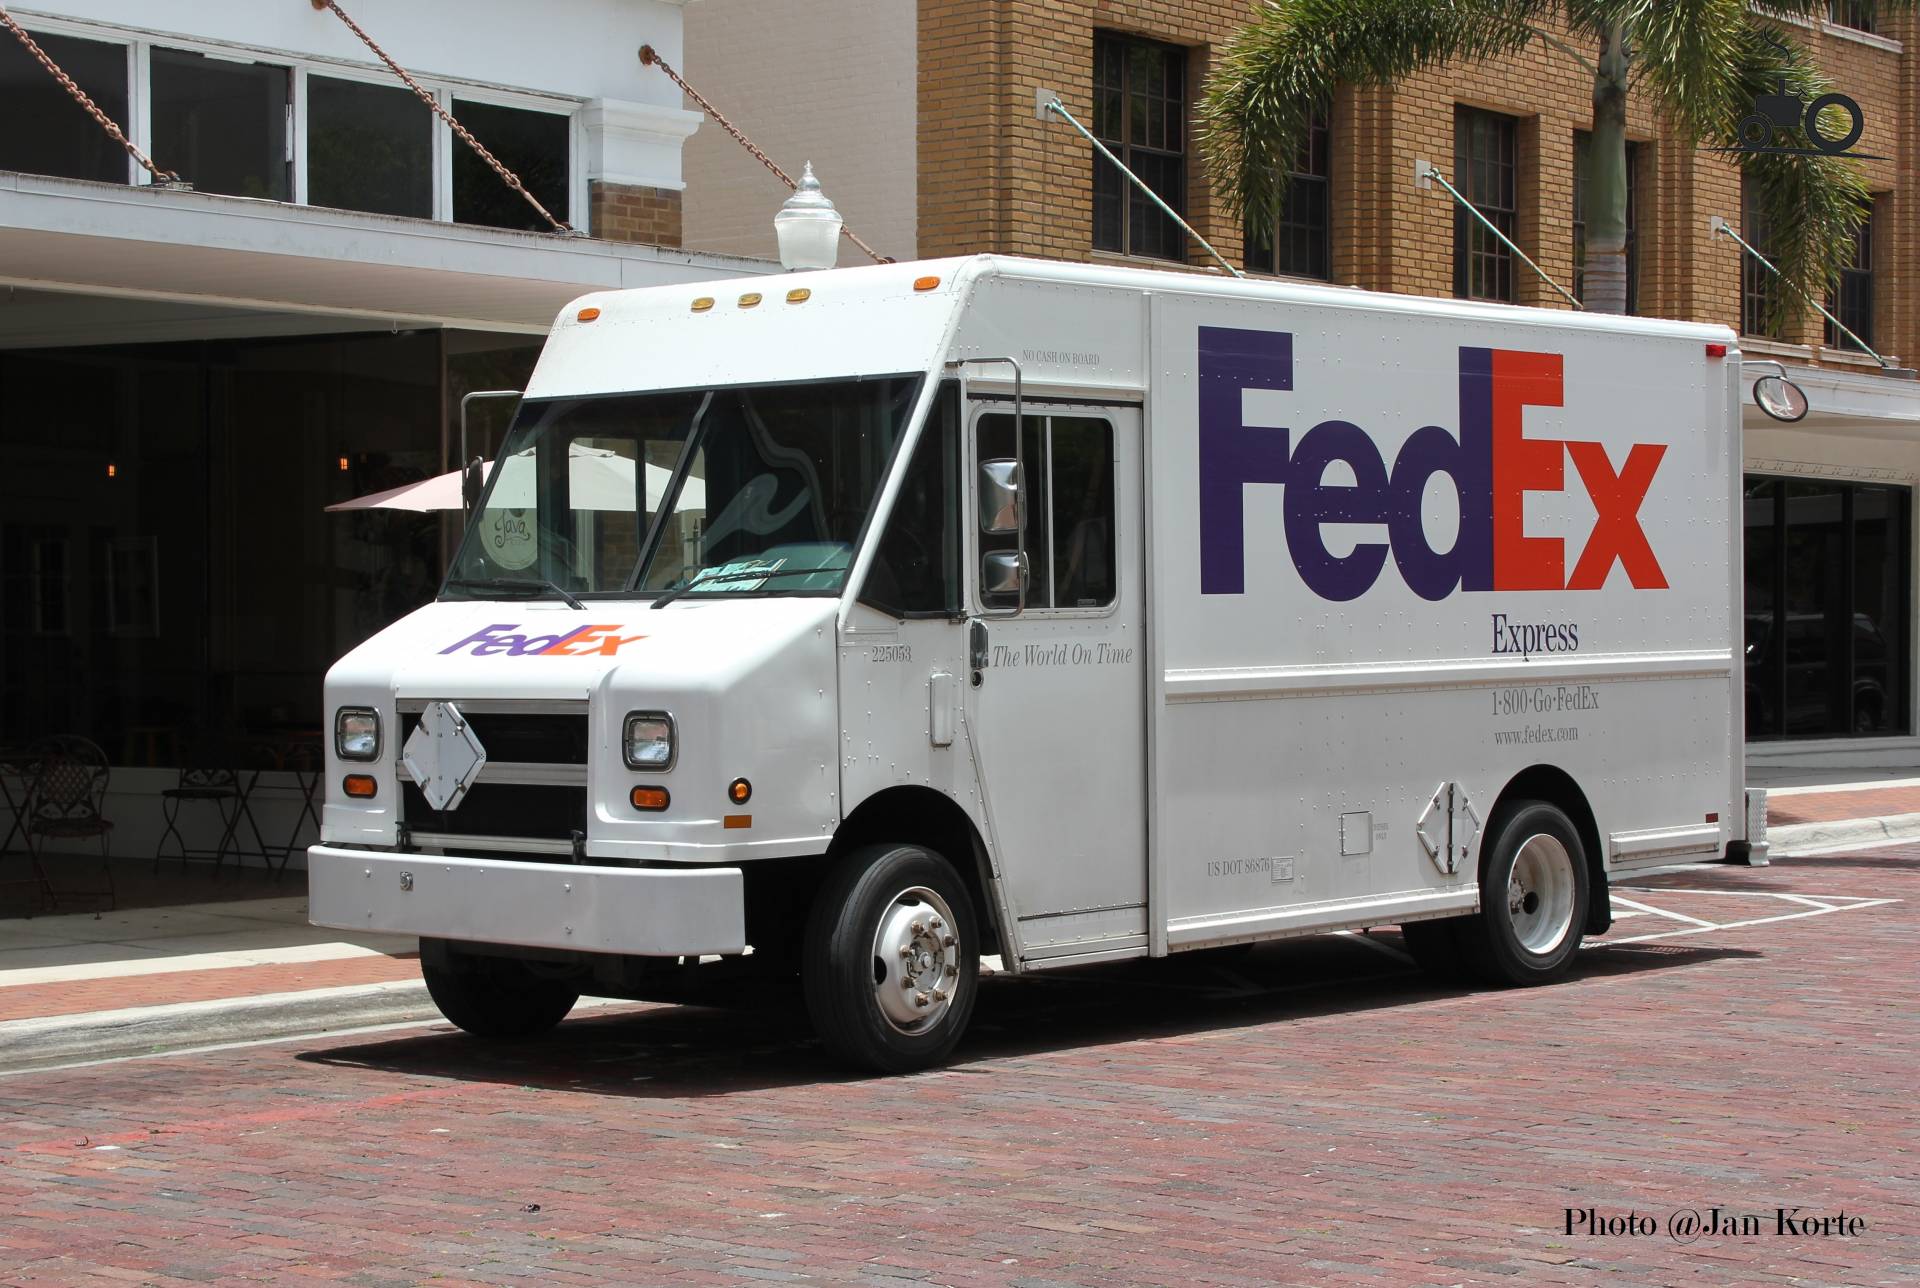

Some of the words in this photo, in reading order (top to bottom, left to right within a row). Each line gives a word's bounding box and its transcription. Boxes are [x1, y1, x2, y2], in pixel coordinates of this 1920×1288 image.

[1023, 349, 1034, 361] NO
[1036, 350, 1057, 363] CASH
[1059, 351, 1071, 364] ON
[1072, 352, 1100, 365] BOARD
[1198, 325, 1670, 602] FedEx
[495, 508, 531, 548] Java
[434, 623, 651, 656] FedEx
[1491, 613, 1579, 661] Express
[993, 645, 1020, 667] The
[1024, 643, 1068, 666] World
[1071, 642, 1092, 665] On
[1096, 642, 1133, 664] Time
[1494, 724, 1579, 745] www.fedex.com
[1207, 861, 1220, 877] US
[1223, 859, 1243, 875] DOT
